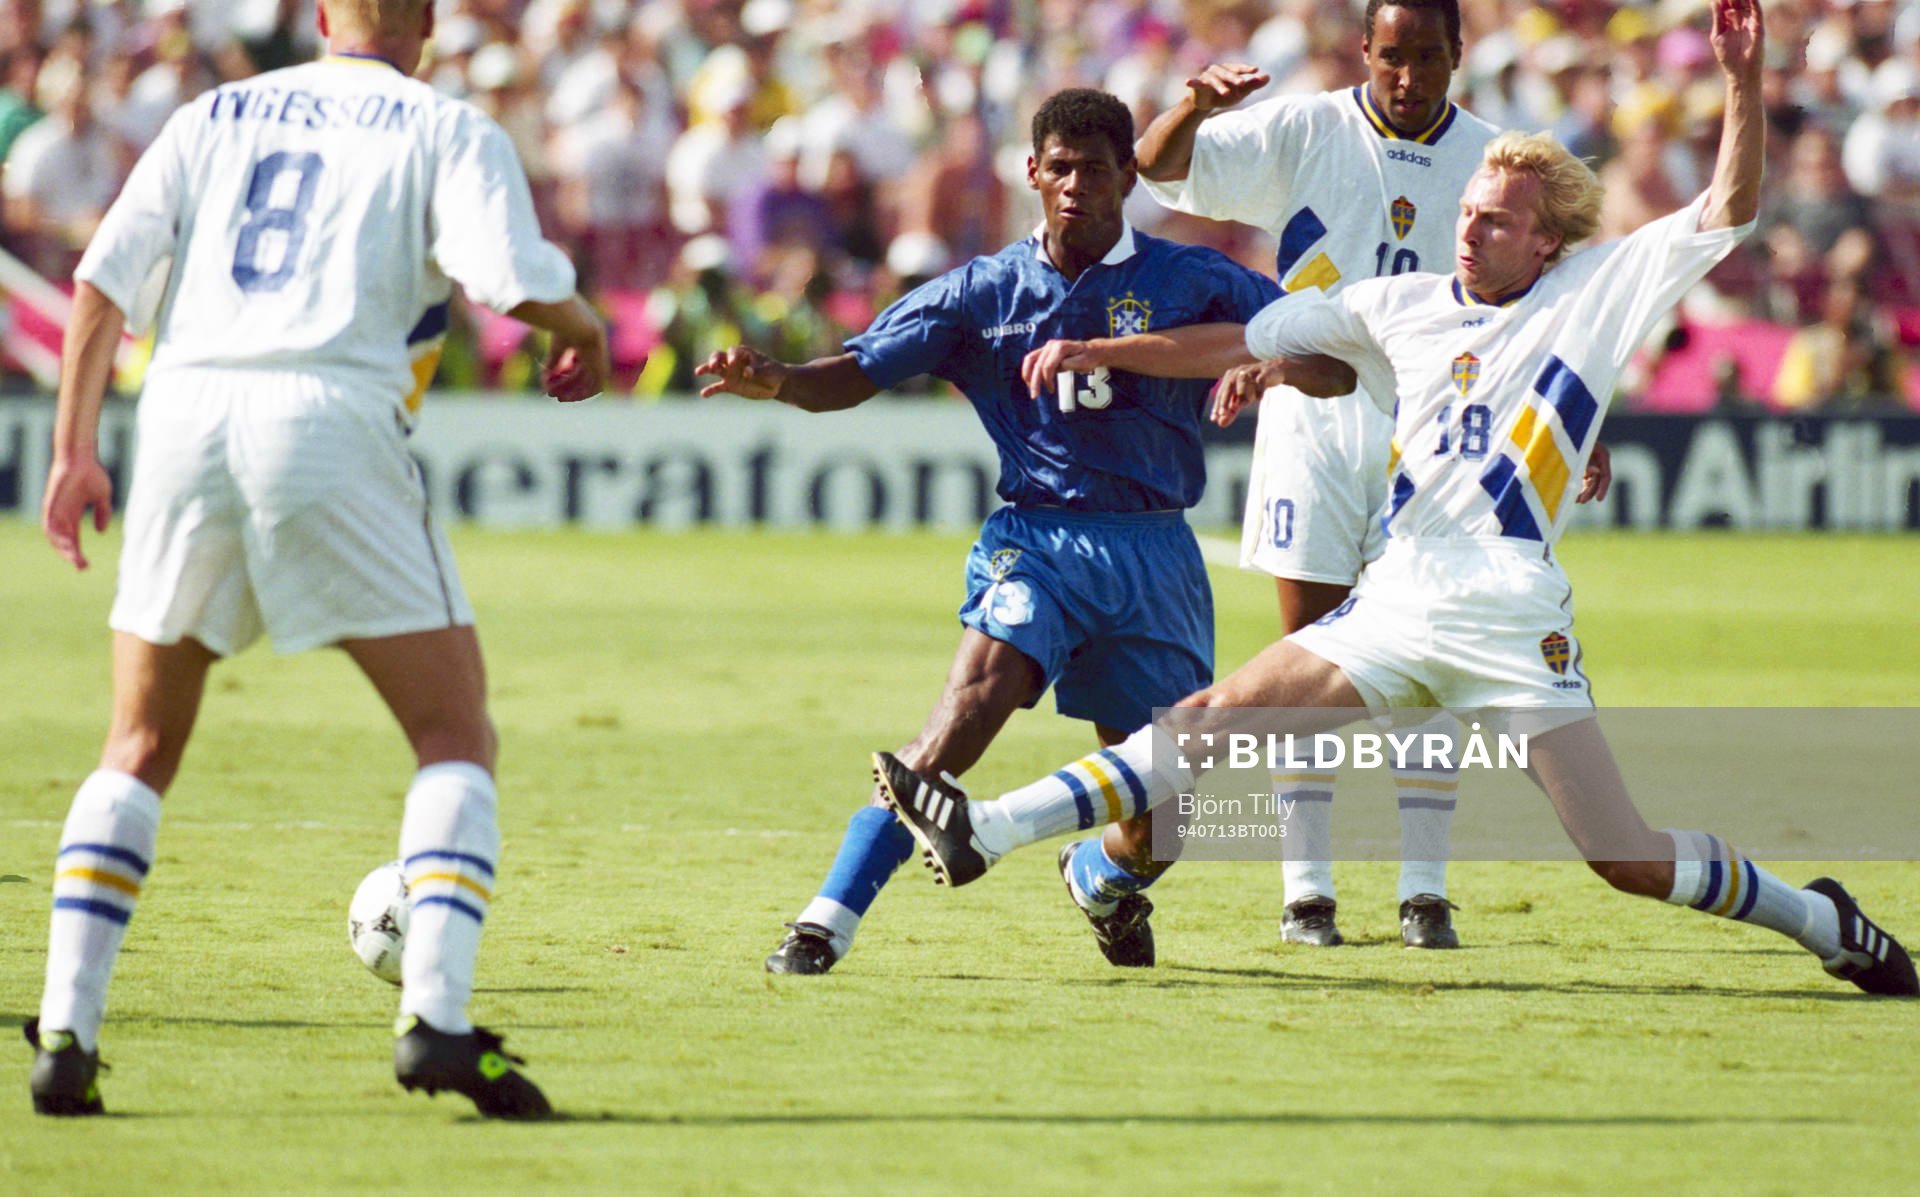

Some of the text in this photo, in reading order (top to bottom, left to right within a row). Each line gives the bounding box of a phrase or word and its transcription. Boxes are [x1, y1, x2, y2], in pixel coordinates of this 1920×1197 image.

[1386, 149, 1432, 168] adidas
[231, 150, 324, 292] 8
[1056, 366, 1113, 413] 13
[1434, 404, 1493, 461] 18
[412, 428, 994, 524] eraton
